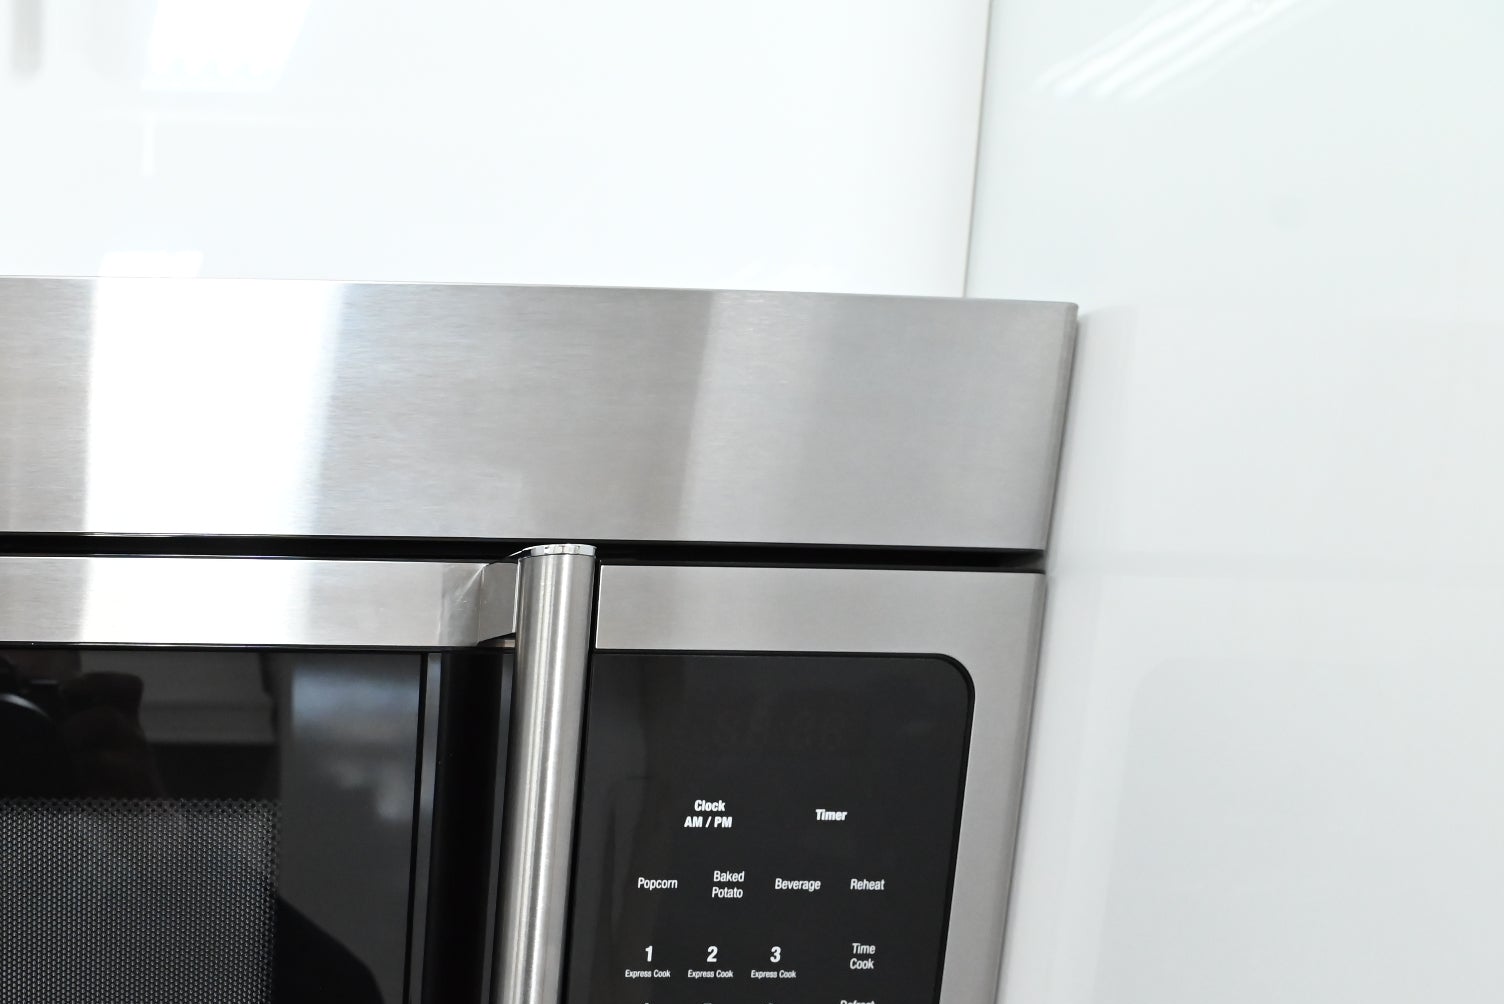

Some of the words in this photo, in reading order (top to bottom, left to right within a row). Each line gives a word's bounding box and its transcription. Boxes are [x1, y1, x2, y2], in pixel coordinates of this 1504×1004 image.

[693, 799, 726, 812] Clock
[815, 808, 849, 822] Timer
[683, 816, 704, 829] AM
[713, 816, 733, 829] PM
[713, 870, 746, 883] Baked
[637, 876, 679, 892] Popcorn
[774, 877, 822, 893] Beverage
[849, 878, 886, 891] Reheat
[711, 886, 744, 899] Potato
[644, 945, 653, 963] 1
[706, 945, 719, 963] 2
[769, 945, 782, 963] 3
[851, 942, 876, 955] Time
[849, 957, 875, 970] Cook
[624, 968, 653, 980] Express
[652, 969, 672, 979] Cook
[687, 968, 715, 980] Express
[715, 969, 734, 979] Cook
[750, 968, 778, 980] Express
[778, 969, 797, 979] Cook
